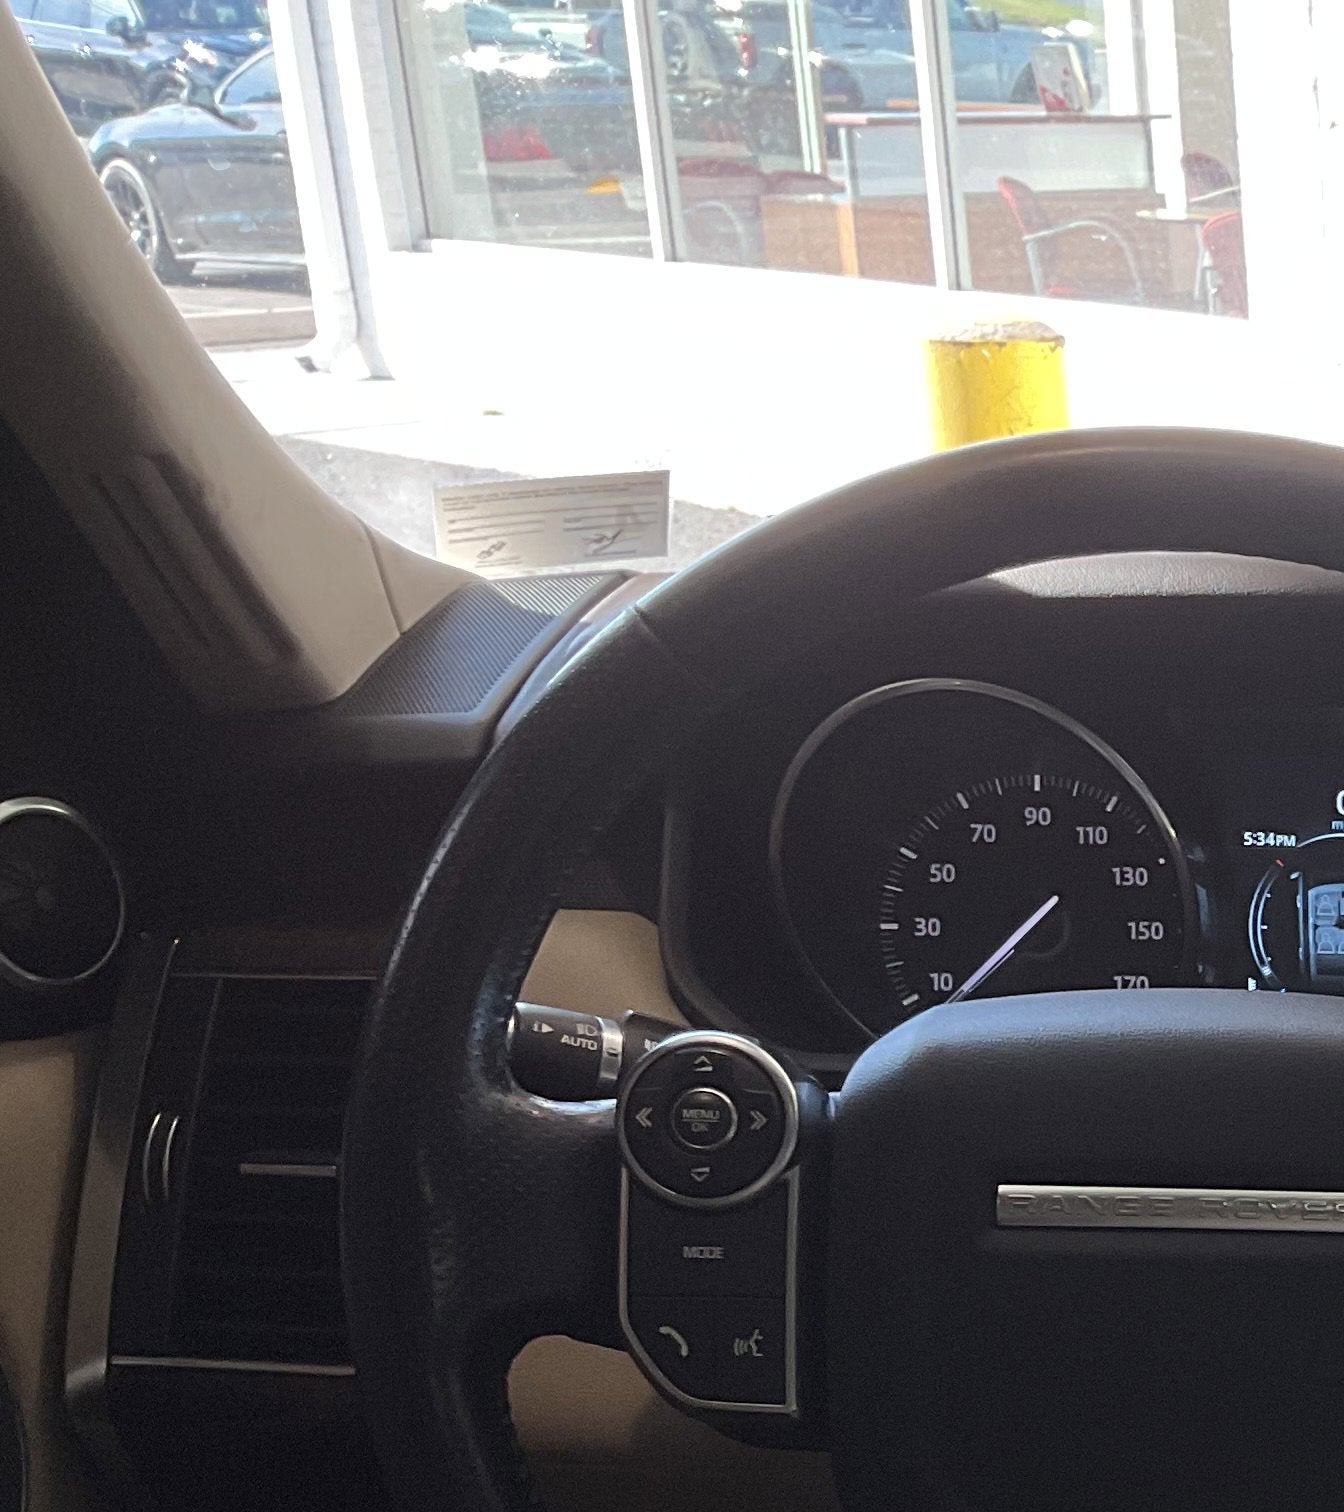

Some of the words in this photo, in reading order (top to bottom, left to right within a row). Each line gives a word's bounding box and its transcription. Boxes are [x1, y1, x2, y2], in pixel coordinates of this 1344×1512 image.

[1024, 808, 1051, 825] 90
[970, 824, 997, 842] 70
[1076, 827, 1108, 845] 110
[929, 864, 955, 882] 50
[1112, 867, 1148, 885] 130
[914, 918, 941, 936] 30
[1127, 922, 1164, 939] 150
[930, 974, 953, 991] 10
[1113, 975, 1149, 990] 170
[560, 1033, 598, 1051] AUTO
[682, 1109, 720, 1119] MENU
[682, 1246, 724, 1259] MODE
